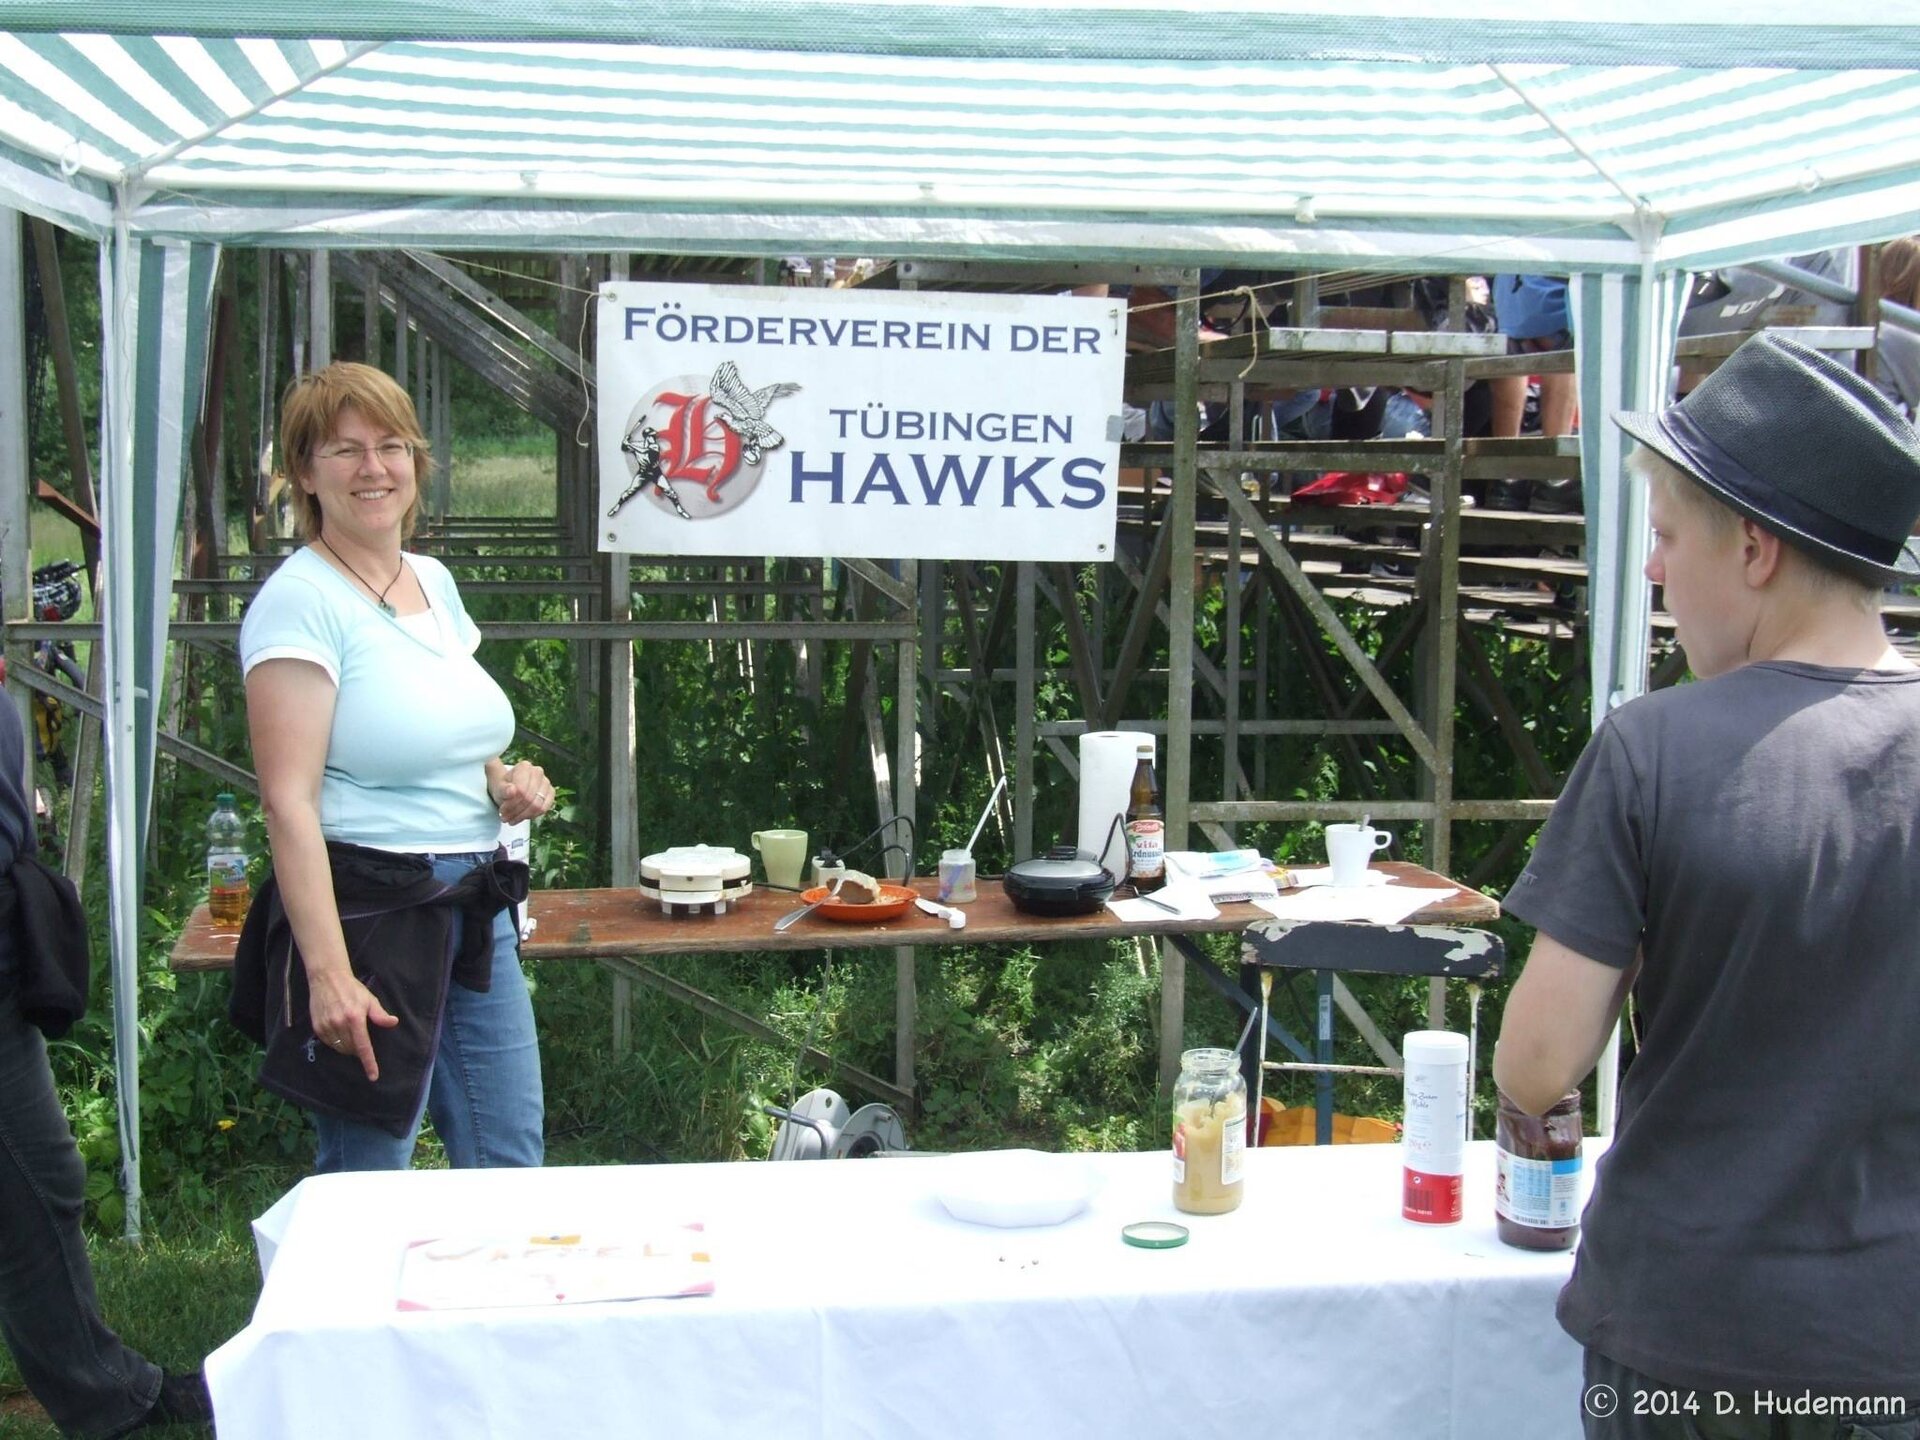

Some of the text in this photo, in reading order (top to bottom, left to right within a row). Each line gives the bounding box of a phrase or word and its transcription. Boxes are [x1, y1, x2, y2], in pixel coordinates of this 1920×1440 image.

[624, 302, 1102, 354] FÖRDERVEREIN DER
[829, 402, 1073, 444] TÜBINGEN
[789, 450, 1107, 511] HAWKS
